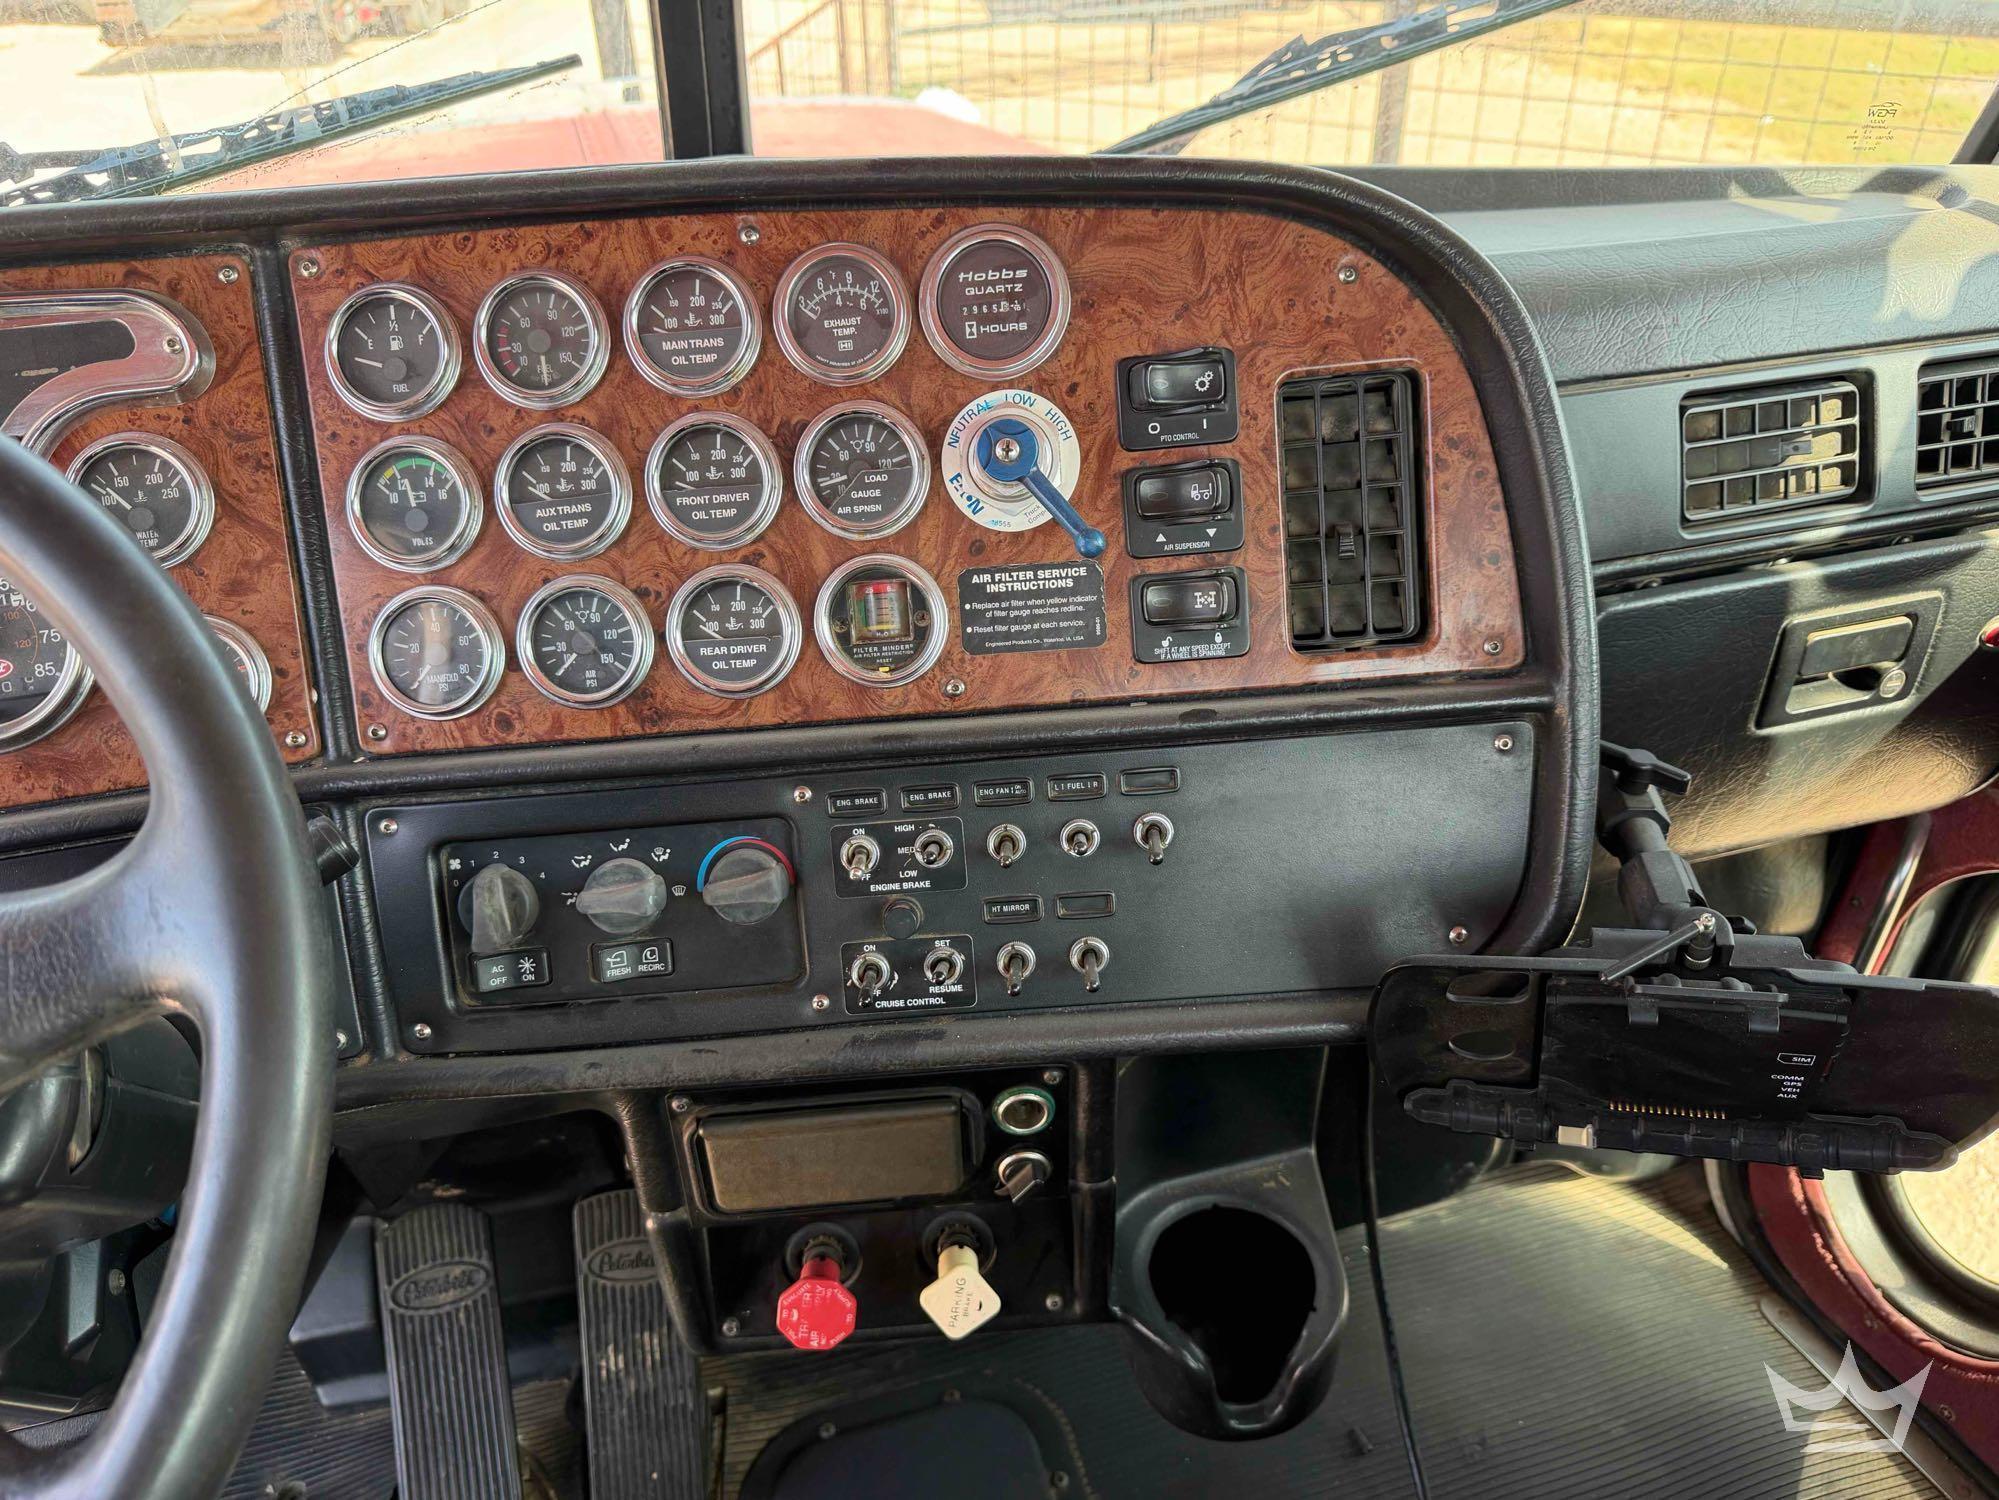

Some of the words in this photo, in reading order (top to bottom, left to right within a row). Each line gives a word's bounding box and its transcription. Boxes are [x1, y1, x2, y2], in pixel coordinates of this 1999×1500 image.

[845, 271, 853, 284] 9
[958, 268, 1028, 283] Hobbs
[817, 277, 824, 290] 6
[869, 280, 880, 293] 12
[965, 283, 1023, 296] QUARTZ
[669, 299, 679, 308] 150
[689, 295, 706, 307] 200
[546, 310, 557, 321] 90
[709, 314, 725, 326] 300
[520, 317, 531, 328] 60
[664, 317, 678, 329] 100
[824, 316, 862, 329] EXHAUST
[980, 322, 1028, 334] HOURS
[561, 326, 575, 338] 120
[367, 339, 374, 350] E
[418, 334, 424, 345] F
[662, 340, 688, 351] MAIN
[689, 337, 724, 349] TRANS
[511, 342, 522, 353] 30
[519, 355, 528, 366] 10
[559, 352, 573, 364] 150
[671, 355, 688, 365] OIL
[689, 353, 718, 364] TEMP
[392, 383, 410, 393] FUEL
[1044, 407, 1073, 442] HIGH
[1160, 434, 1172, 442] PTO
[1173, 432, 1200, 441] CONTROL
[864, 441, 876, 453] 90
[710, 449, 727, 460] 200
[839, 450, 850, 461] 60
[560, 461, 577, 473] 200
[730, 467, 746, 478] 300
[114, 475, 130, 488] 150
[145, 472, 164, 485] 200
[685, 470, 700, 482] 100
[864, 473, 888, 483] LOAD
[424, 476, 435, 488] 14
[580, 479, 597, 490] 300
[161, 487, 179, 499] 250
[389, 492, 399, 504] 10
[850, 489, 882, 499] GAUGE
[101, 495, 118, 506] 100
[676, 495, 710, 507] FRONT
[712, 492, 751, 504] DRIVER
[535, 506, 556, 518] AUX
[556, 502, 592, 515] TRANS
[691, 510, 709, 520] OIL
[710, 507, 738, 519] TEMP
[837, 505, 852, 515] AIR
[853, 503, 882, 514] SPNSN
[542, 522, 560, 532] OIL
[560, 518, 589, 530] TEMP
[412, 537, 434, 547] VOLTS
[1163, 543, 1174, 551] AIR
[1174, 540, 1211, 550] SUSPENSION
[971, 573, 992, 584] AIR
[994, 570, 1035, 583] FILTER
[1037, 566, 1088, 580] SERVICE
[986, 578, 1075, 593] INSTRUCTIONS
[730, 600, 746, 612] 200
[972, 602, 1000, 611] Replace
[1001, 600, 1010, 608] air
[1011, 599, 1026, 608] filter
[1026, 598, 1046, 606] when
[1046, 596, 1068, 606] yellow
[1068, 594, 1098, 603] indicator
[985, 610, 994, 618] of
[993, 609, 1009, 618] filter
[1009, 609, 1031, 619] gauge
[1032, 606, 1060, 615] reaches
[1060, 604, 1086, 613] redline.
[589, 612, 601, 623] 90
[430, 622, 441, 633] 40
[564, 620, 575, 631] 60
[705, 621, 719, 632] 100
[749, 618, 765, 629] 300
[973, 624, 994, 634] Reset
[994, 623, 1009, 632] filter
[1010, 622, 1032, 633] gauge
[1033, 621, 1040, 630] at
[1041, 620, 1058, 629] each
[1059, 618, 1086, 628] service.
[39, 628, 62, 644] 75
[603, 628, 618, 640] 120
[458, 634, 470, 646] 60
[985, 639, 1012, 648] Engineered
[1012, 638, 1033, 646] Products
[409, 642, 420, 654] 20
[555, 641, 567, 652] 30
[700, 646, 728, 656] REAR
[730, 643, 767, 655] DRIVER
[853, 646, 878, 655] FILTER
[1154, 647, 1170, 656] SHIFT
[1178, 645, 1191, 653] ANY
[1191, 644, 1209, 652] SPEED
[1210, 642, 1231, 651] EXCEPT
[600, 653, 614, 664] 150
[1171, 651, 1191, 659] WHEEL
[1192, 650, 1198, 658] IS
[34, 661, 56, 678] 85
[712, 660, 729, 670] OIL
[729, 658, 757, 669] TEMP
[585, 669, 597, 679] AIR
[586, 678, 598, 688] PSI
[979, 787, 994, 796] ENG
[995, 786, 1010, 795] FAN
[1067, 781, 1086, 790] FUEL
[910, 793, 926, 801] ENG.
[928, 790, 952, 799] BRAKE
[836, 799, 853, 807] ENG.
[854, 796, 879, 805] BRAKE
[852, 828, 865, 836] ON
[894, 823, 915, 833] HIGH
[493, 851, 499, 859] 2
[897, 846, 915, 855] MED
[518, 856, 526, 864] 3
[899, 869, 918, 878] LOW
[870, 883, 901, 892] ENGINE
[902, 880, 931, 890] BRAKE
[991, 905, 1001, 913] HT
[1002, 903, 1030, 912] MIRROR
[863, 944, 876, 952] ON
[934, 939, 951, 947] SET
[491, 964, 505, 974] AC
[607, 966, 632, 978] FRESH
[638, 962, 666, 972] RECIRC
[490, 976, 508, 986] OFF
[522, 973, 536, 982] ON
[929, 984, 964, 994] RESUME
[874, 1000, 905, 1008] CRUISE
[906, 997, 946, 1007] CONTROL
[948, 1276, 967, 1329] PARKING
